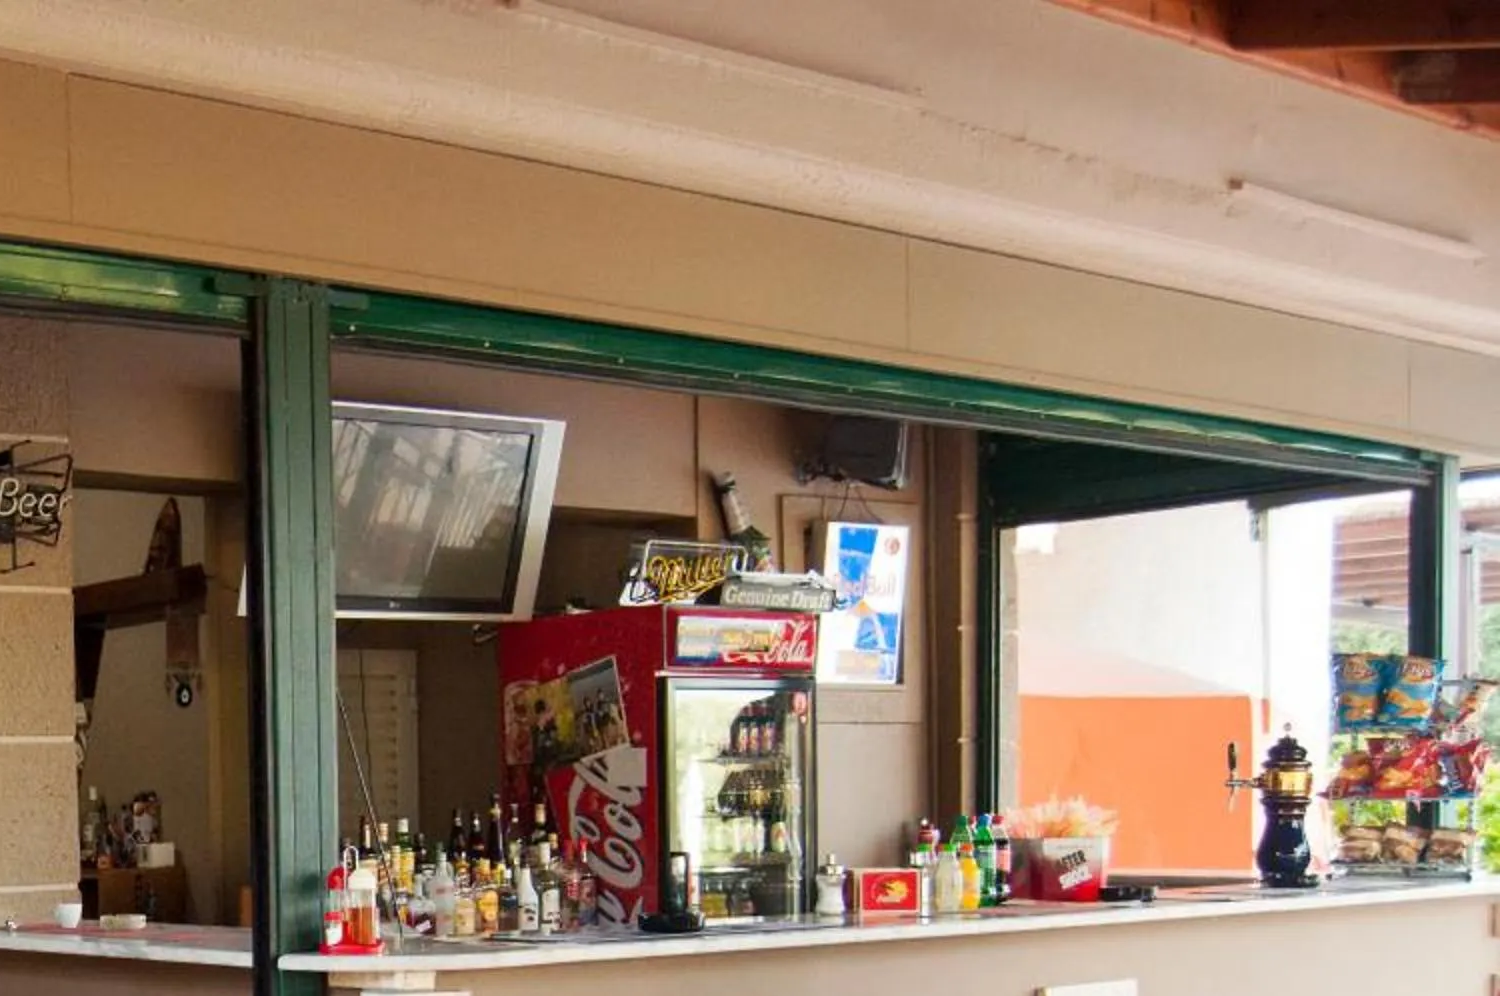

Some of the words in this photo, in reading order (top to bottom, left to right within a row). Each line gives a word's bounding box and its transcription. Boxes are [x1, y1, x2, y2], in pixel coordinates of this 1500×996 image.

[650, 550, 732, 595] Miller
[726, 585, 788, 607] Genuine
[791, 590, 831, 609] Draft
